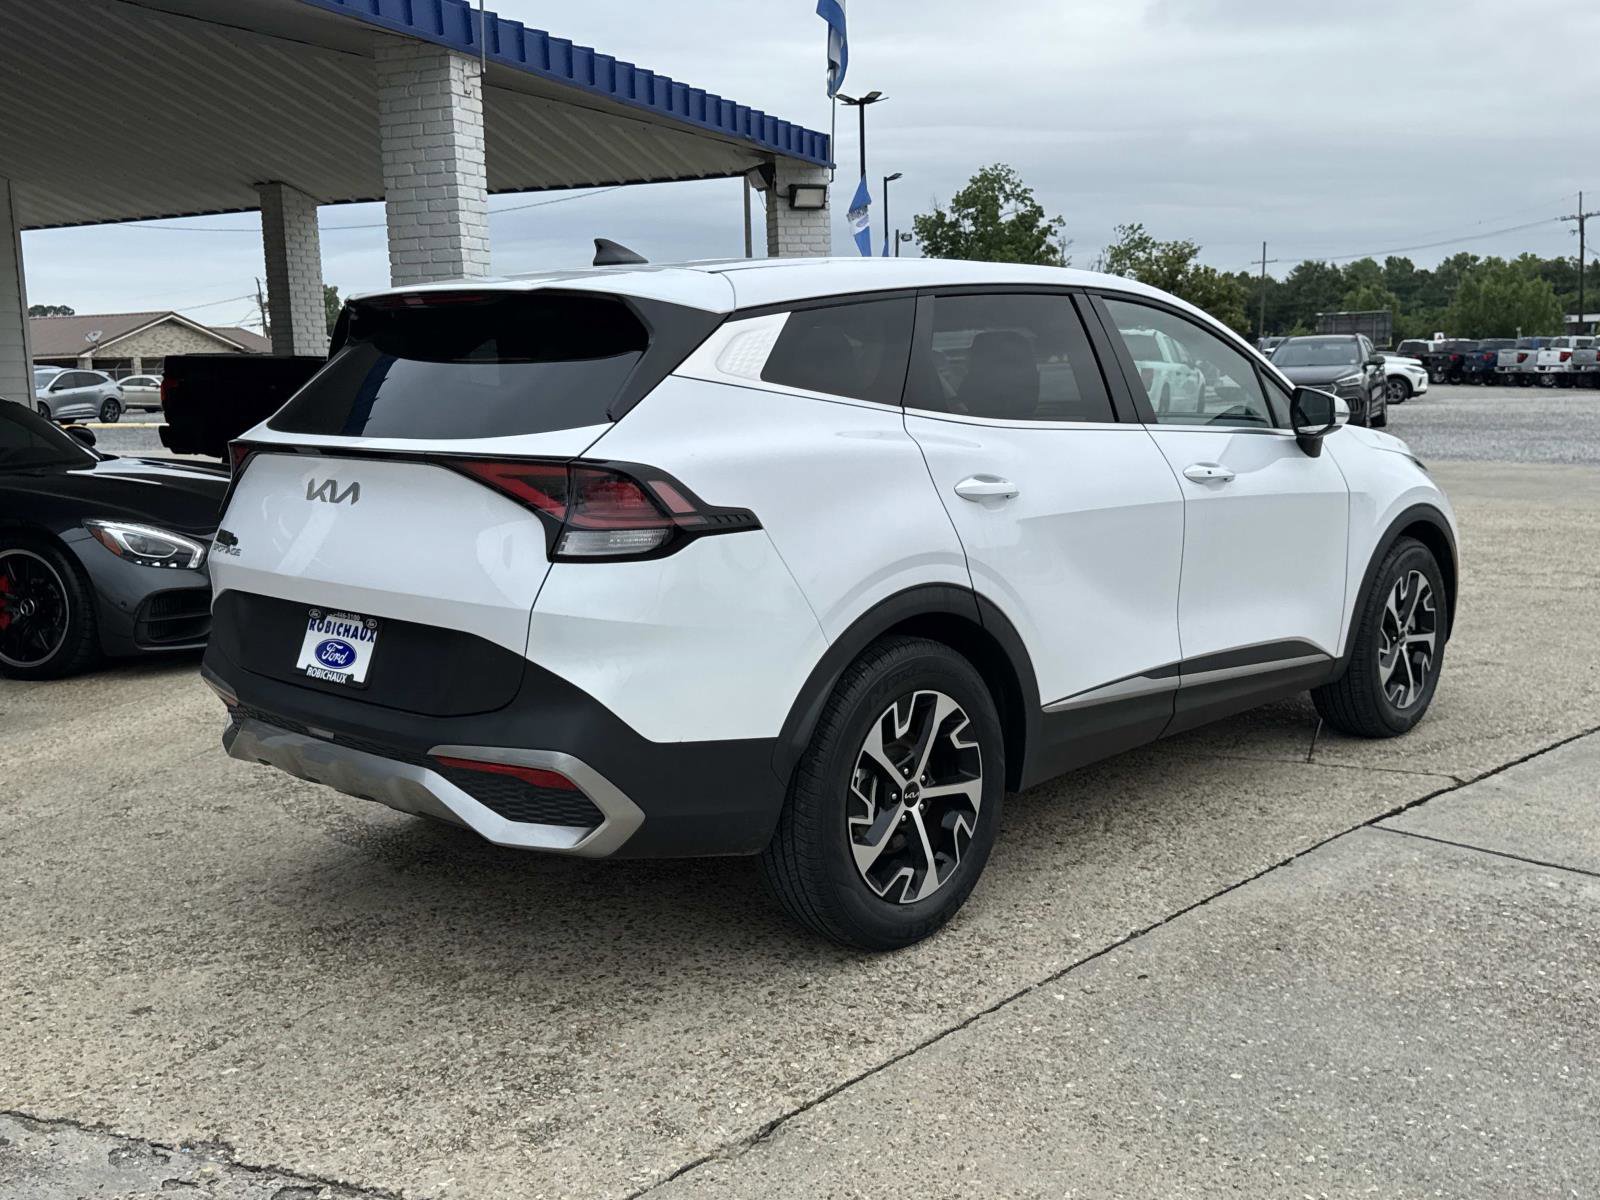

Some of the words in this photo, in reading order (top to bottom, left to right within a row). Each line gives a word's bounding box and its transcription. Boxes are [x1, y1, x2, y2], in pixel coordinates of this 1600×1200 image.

[306, 478, 360, 505] KIA
[309, 619, 376, 643] ROBICHAUX
[322, 642, 349, 665] Ford
[306, 667, 347, 684] ROBICHAUX
